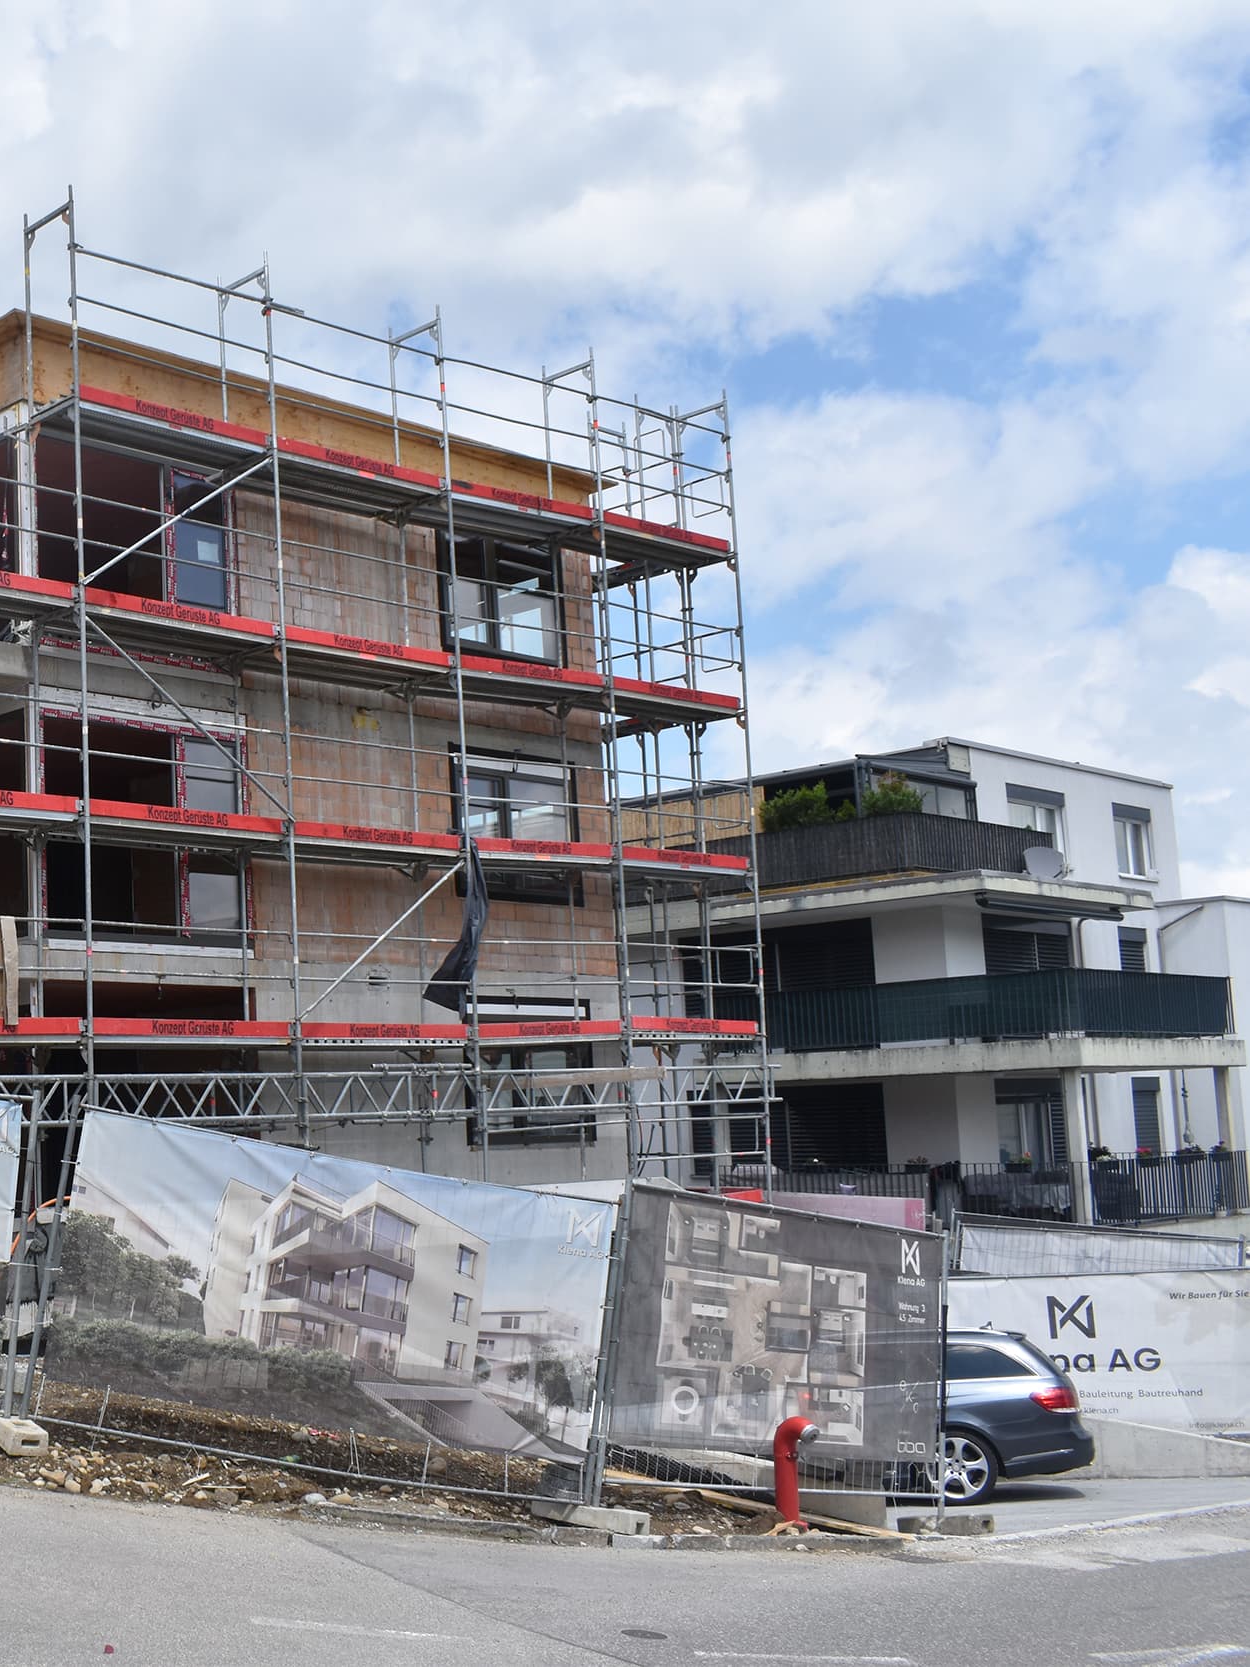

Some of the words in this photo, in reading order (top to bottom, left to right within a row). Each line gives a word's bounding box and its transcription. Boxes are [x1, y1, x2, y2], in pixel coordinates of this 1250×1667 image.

[141, 598, 174, 617] Konzept
[208, 612, 221, 625] AG
[0, 791, 14, 806] AG
[147, 806, 181, 822] Konzept
[216, 813, 229, 826] AG
[152, 1019, 186, 1036] Konzept
[221, 1022, 234, 1035] AG
[916, 1278, 926, 1288] AG
[1169, 1291, 1186, 1300] Wir
[1188, 1291, 1217, 1300] Bauen
[1218, 1290, 1232, 1301] für
[1234, 1288, 1249, 1298] Sie
[1108, 1347, 1162, 1372] AG
[1079, 1389, 1134, 1399] Bauleitung
[1138, 1388, 1204, 1398] Bautreuhand
